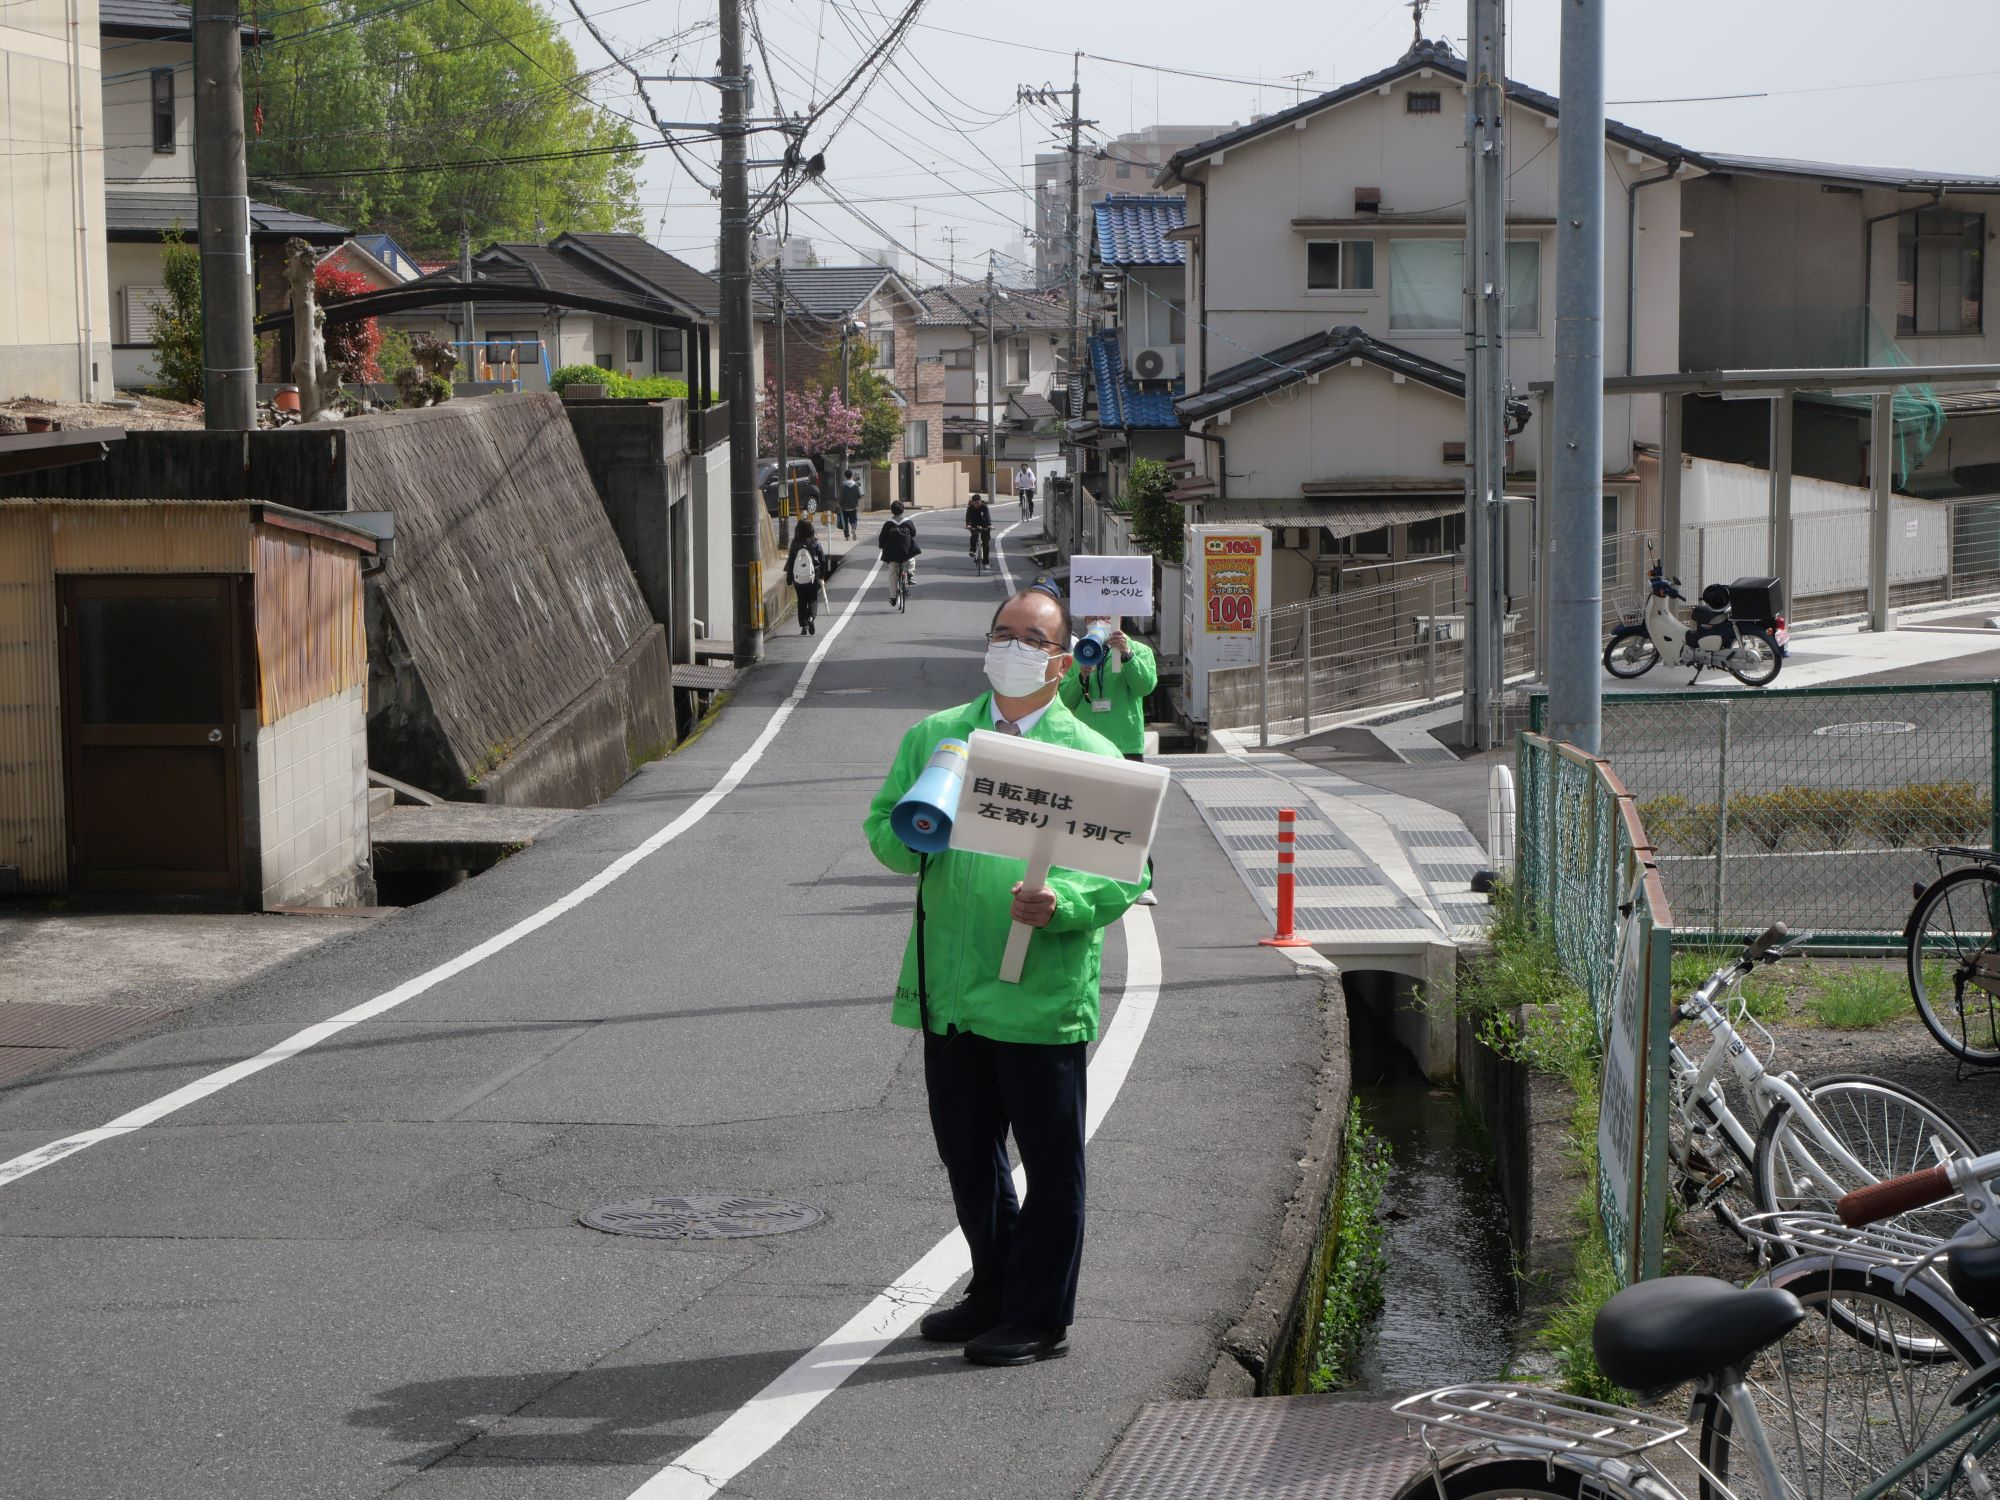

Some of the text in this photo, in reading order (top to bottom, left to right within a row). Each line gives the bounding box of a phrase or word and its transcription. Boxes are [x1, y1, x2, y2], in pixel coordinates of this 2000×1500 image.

[1074, 575, 1138, 585] スピード落とし
[1101, 588, 1143, 597] ゆっくりと
[973, 777, 1074, 811] 自転車は
[978, 802, 1132, 845] 左寄り 1列で
